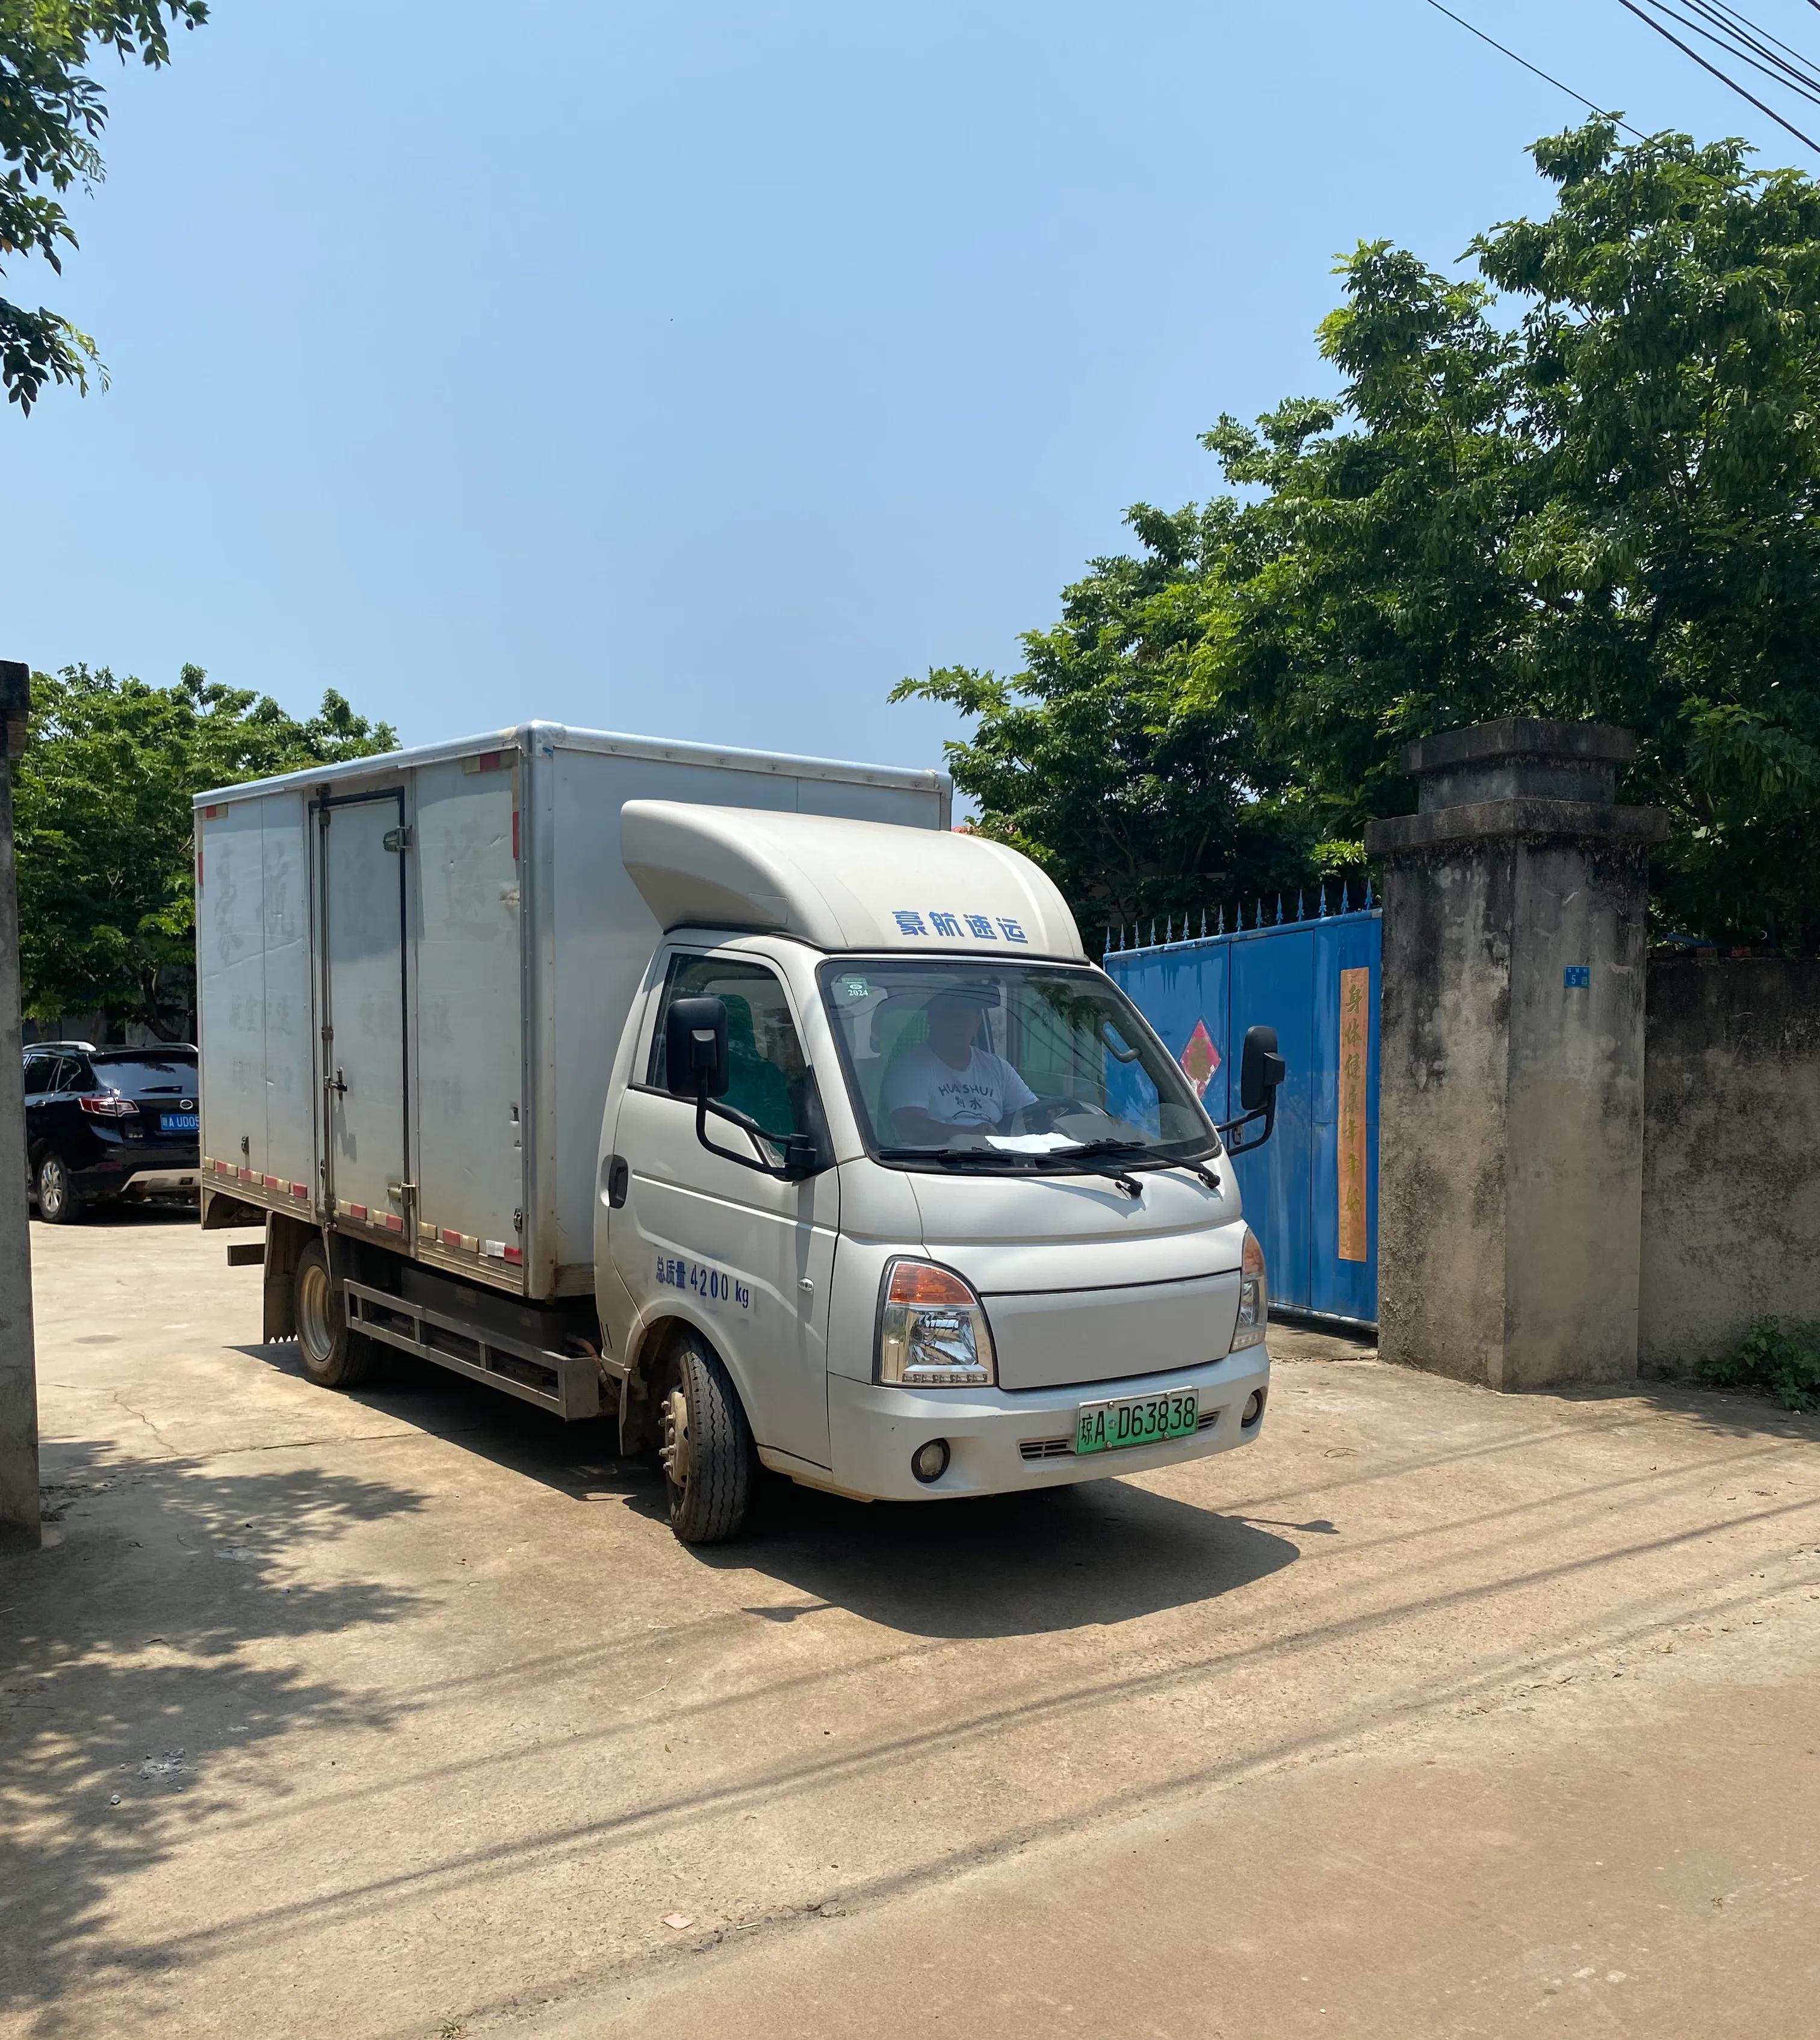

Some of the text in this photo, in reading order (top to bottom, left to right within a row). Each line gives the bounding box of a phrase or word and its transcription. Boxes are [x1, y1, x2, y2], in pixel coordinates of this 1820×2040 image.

[891, 910, 1029, 944] 豪航速运
[1571, 974, 1576, 984] 5
[655, 1256, 749, 1309] 总质量 4200 kg
